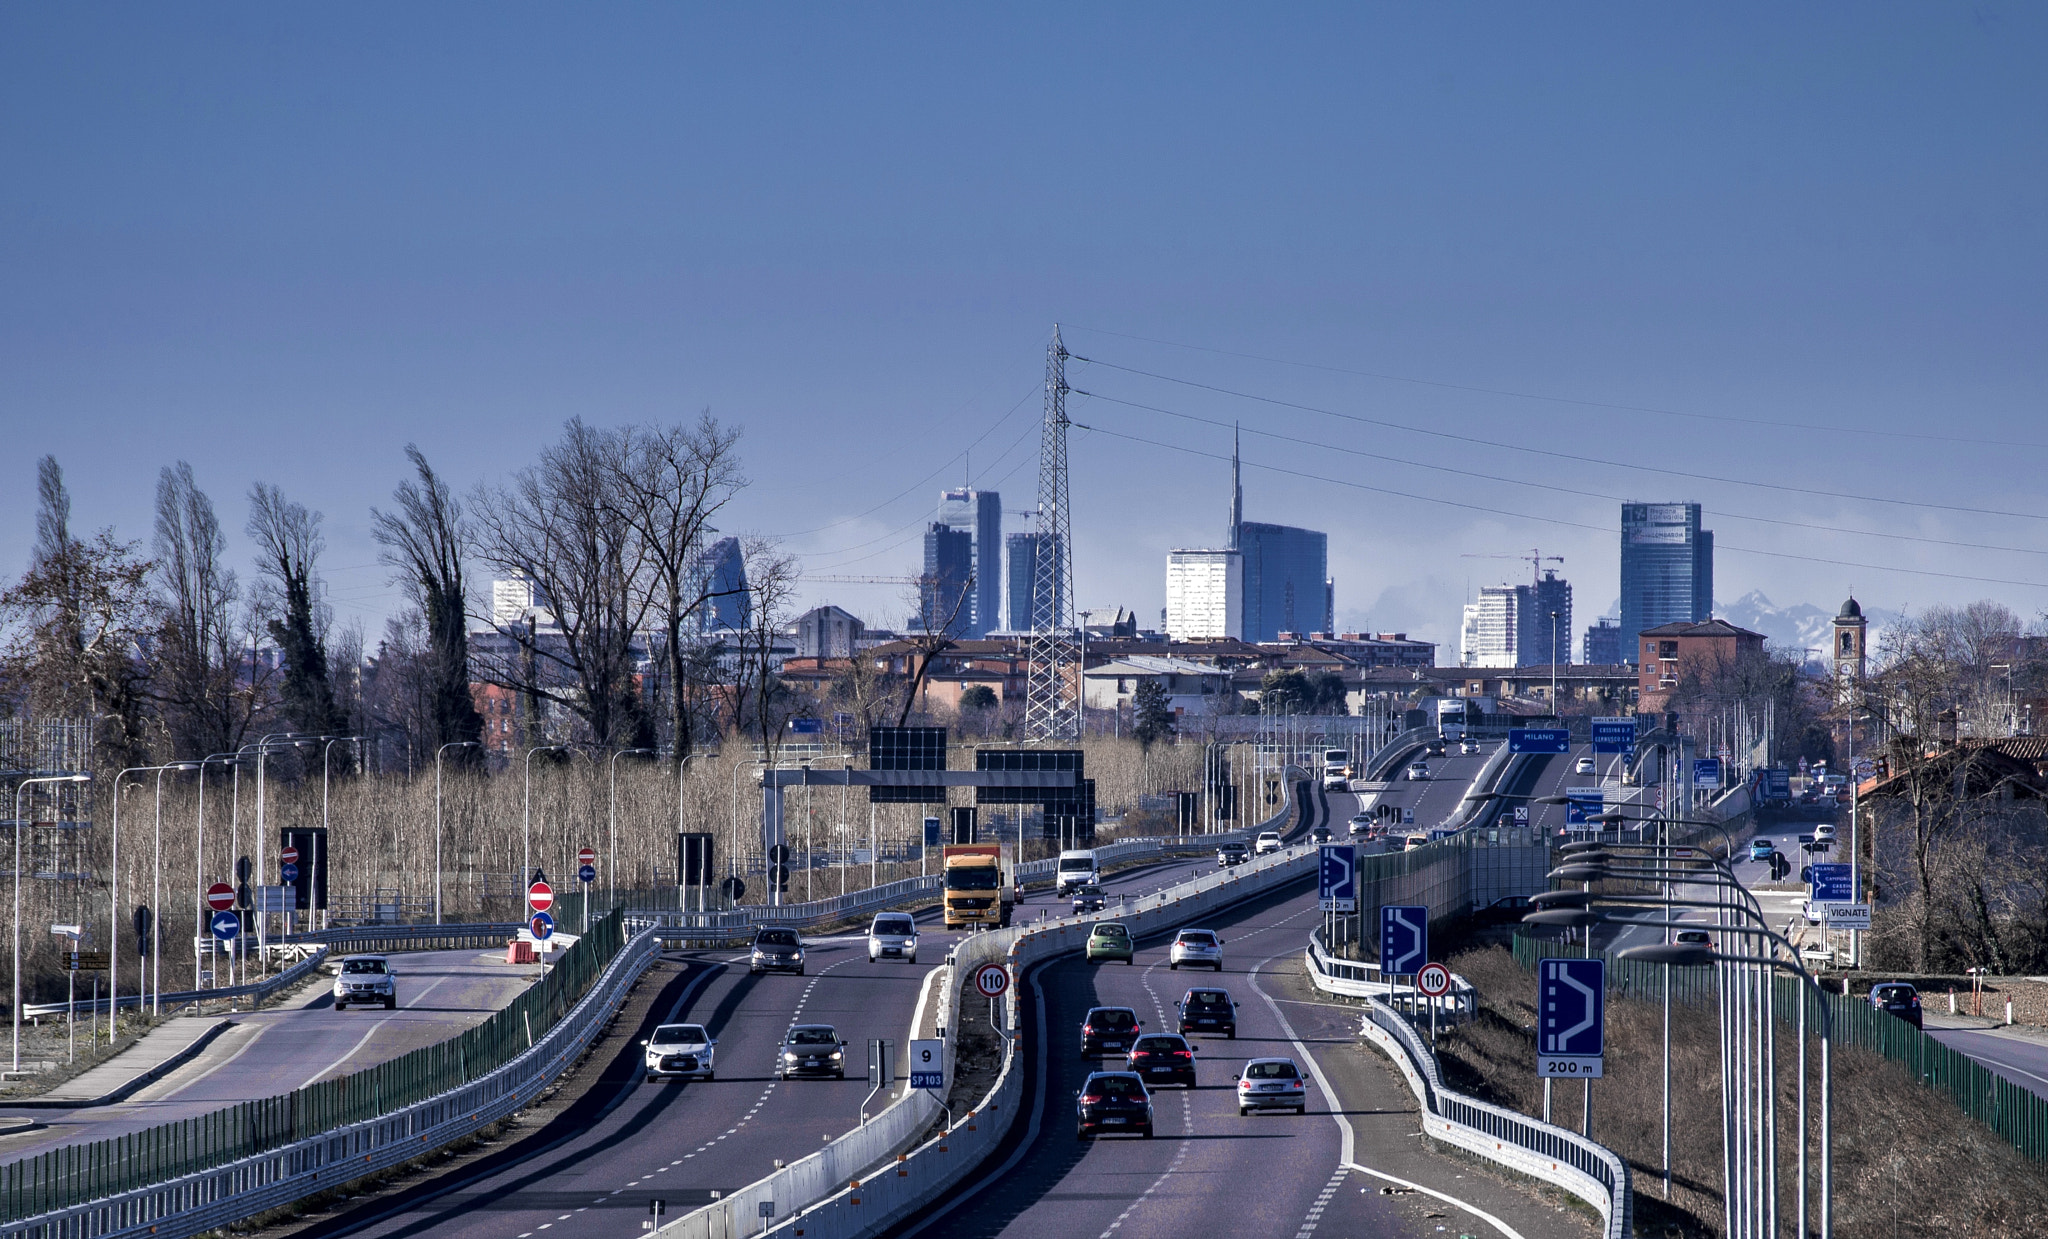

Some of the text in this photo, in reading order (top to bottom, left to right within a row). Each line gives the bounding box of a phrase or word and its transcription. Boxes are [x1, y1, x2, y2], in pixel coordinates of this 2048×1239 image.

[1831, 909, 1868, 917] VIGNATE
[982, 974, 1004, 989] 110
[1425, 973, 1443, 988] 110
[922, 1050, 931, 1062] 9
[1549, 1061, 1577, 1073] 200
[912, 1075, 941, 1085] SP 103
